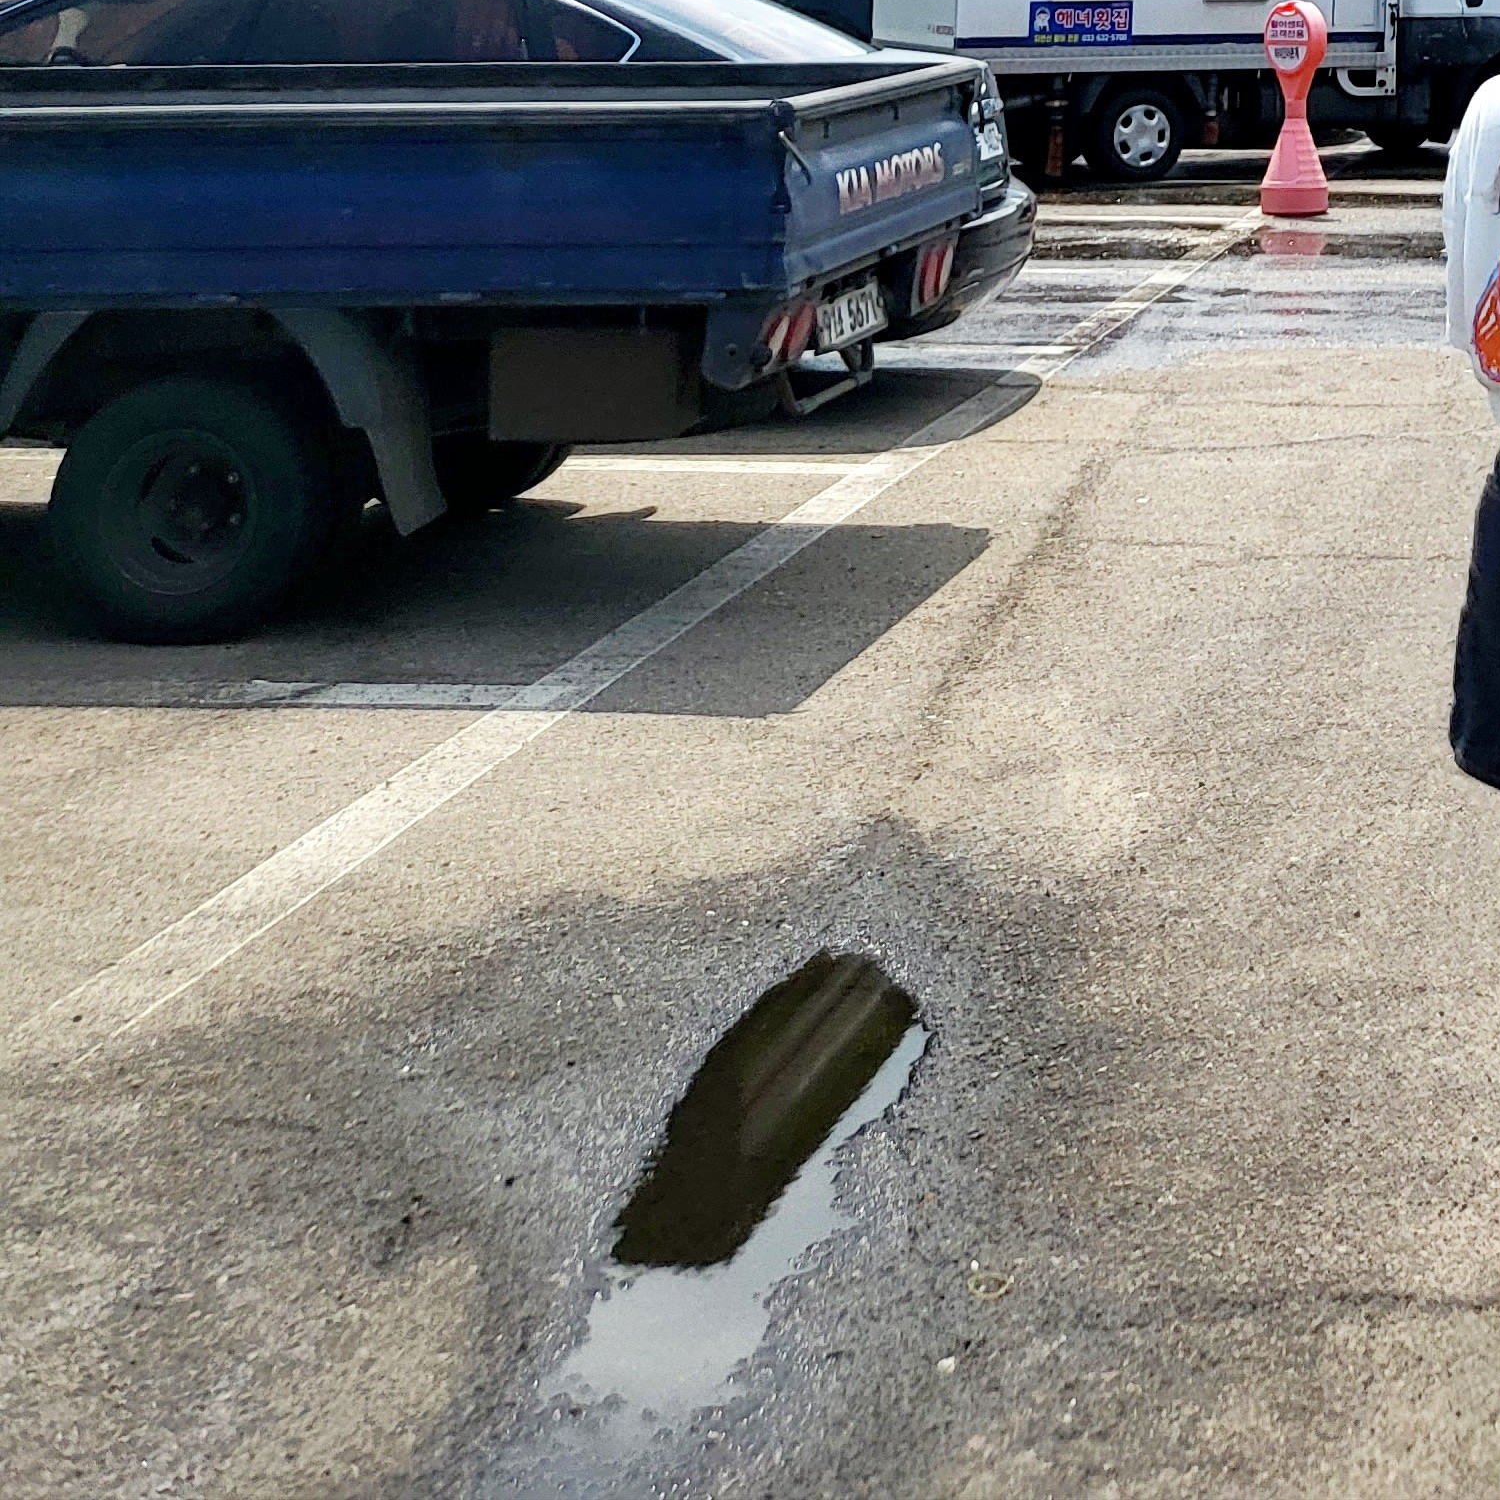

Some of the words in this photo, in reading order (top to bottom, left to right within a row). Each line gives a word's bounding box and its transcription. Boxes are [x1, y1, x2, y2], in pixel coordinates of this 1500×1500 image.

[1054, 7, 1130, 31] 해녀횟집
[835, 164, 873, 215] KIA
[874, 140, 945, 202] MOTORS
